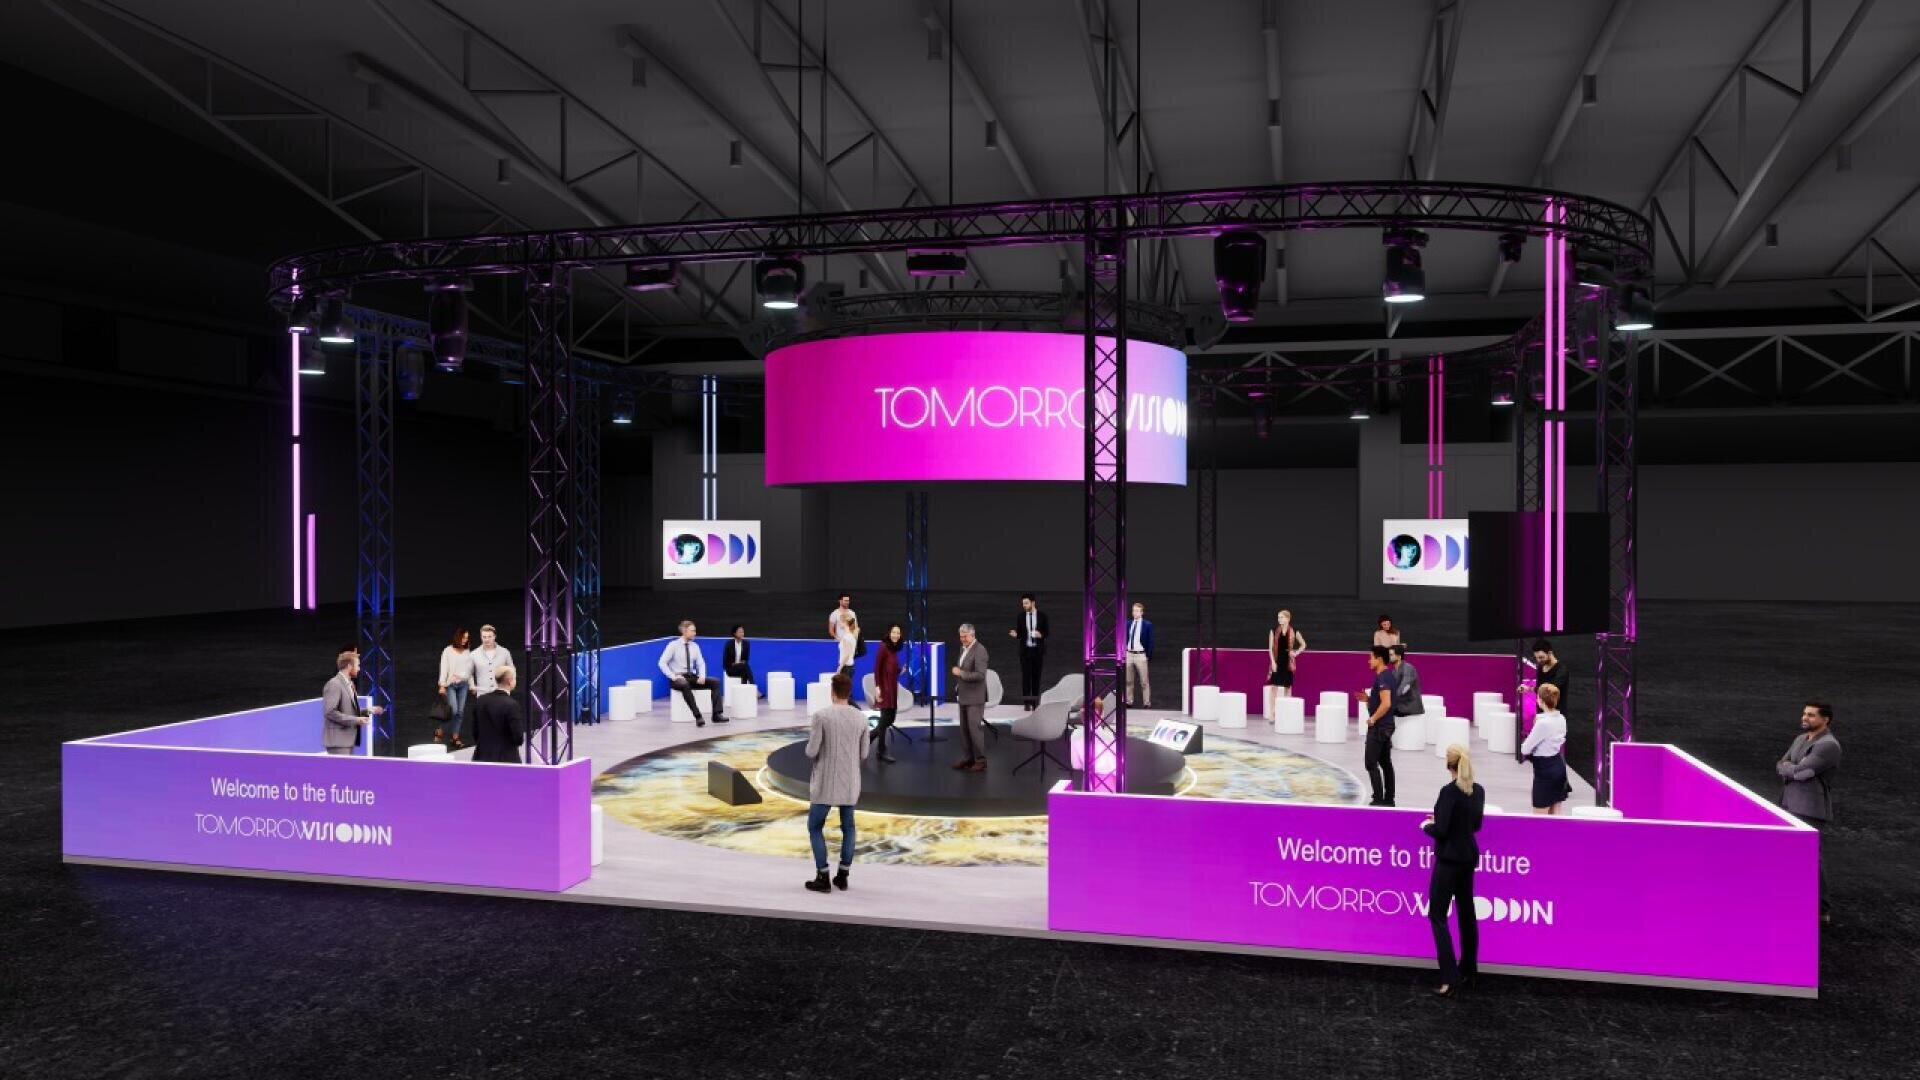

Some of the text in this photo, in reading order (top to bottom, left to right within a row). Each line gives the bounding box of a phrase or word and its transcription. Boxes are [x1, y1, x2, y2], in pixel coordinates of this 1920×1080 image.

[211, 776, 375, 805] Welcome to the future
[1277, 836, 1382, 866] Welcome
[1389, 844, 1411, 868] to
[1474, 850, 1531, 875] uture
